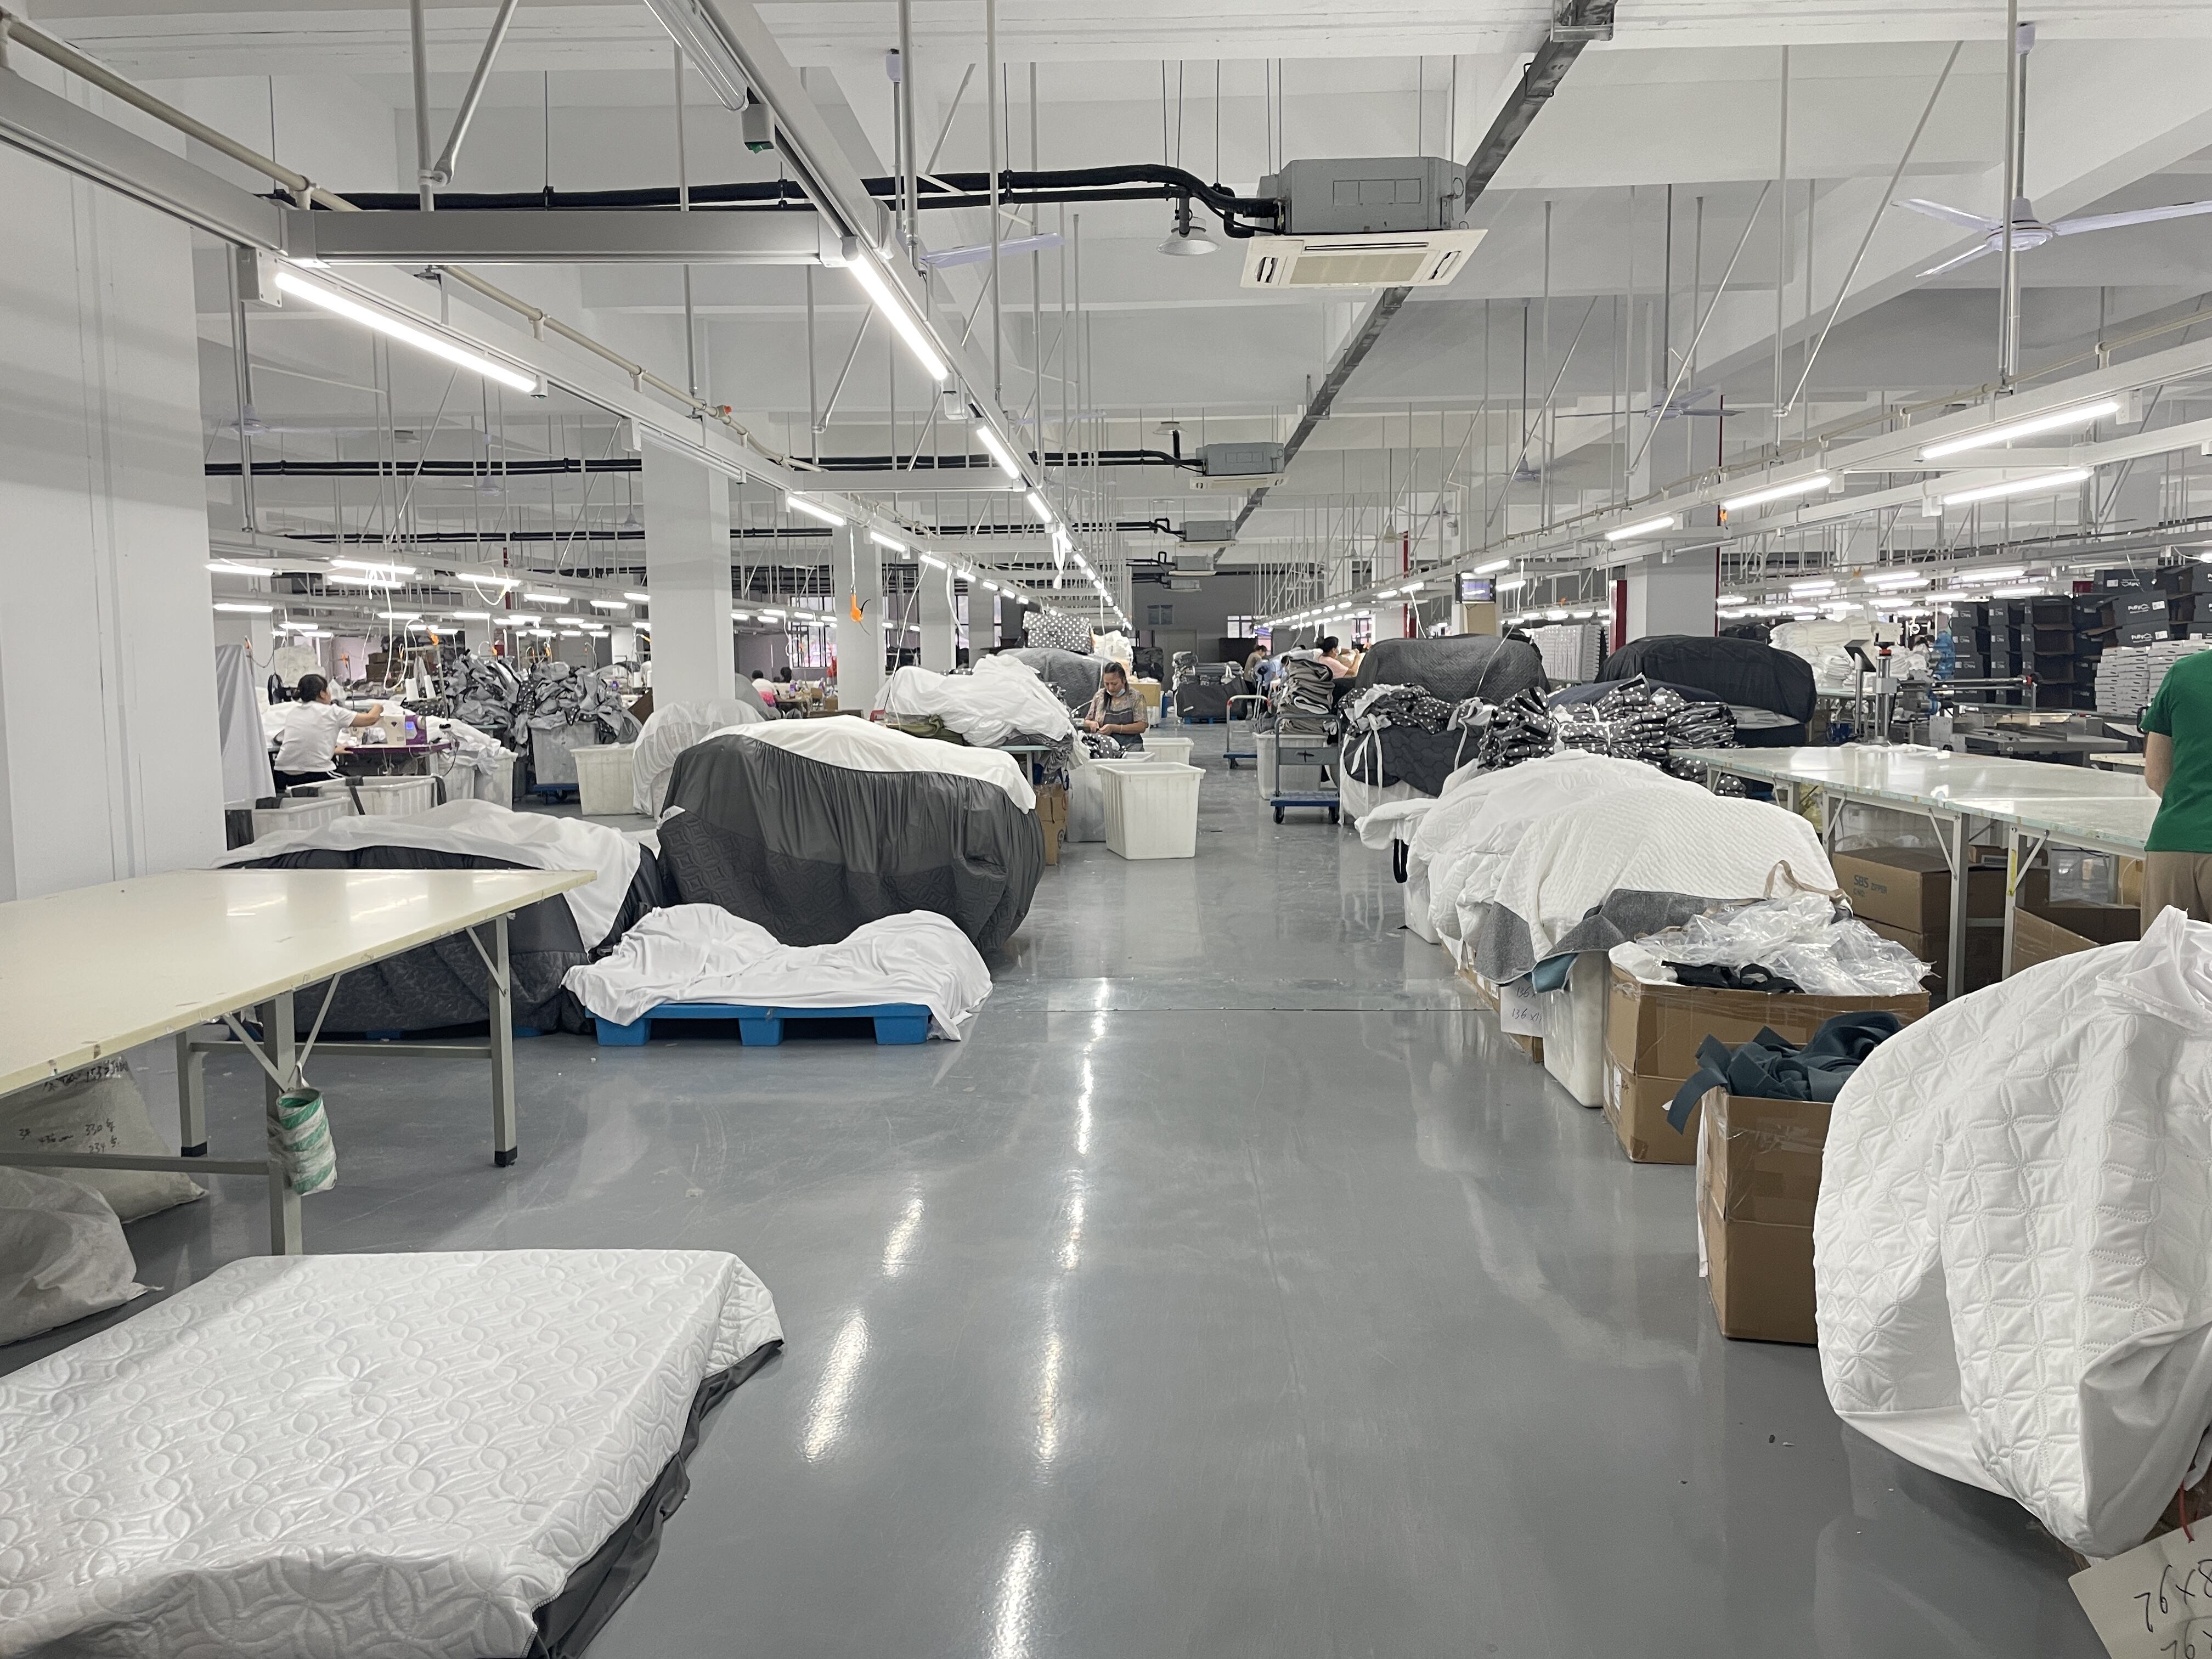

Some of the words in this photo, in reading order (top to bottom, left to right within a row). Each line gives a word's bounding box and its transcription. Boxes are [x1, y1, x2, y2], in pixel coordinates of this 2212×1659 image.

[1853, 874, 1869, 888] SBS
[1516, 986, 1531, 998] 136
[1511, 1008, 1528, 1019] 136
